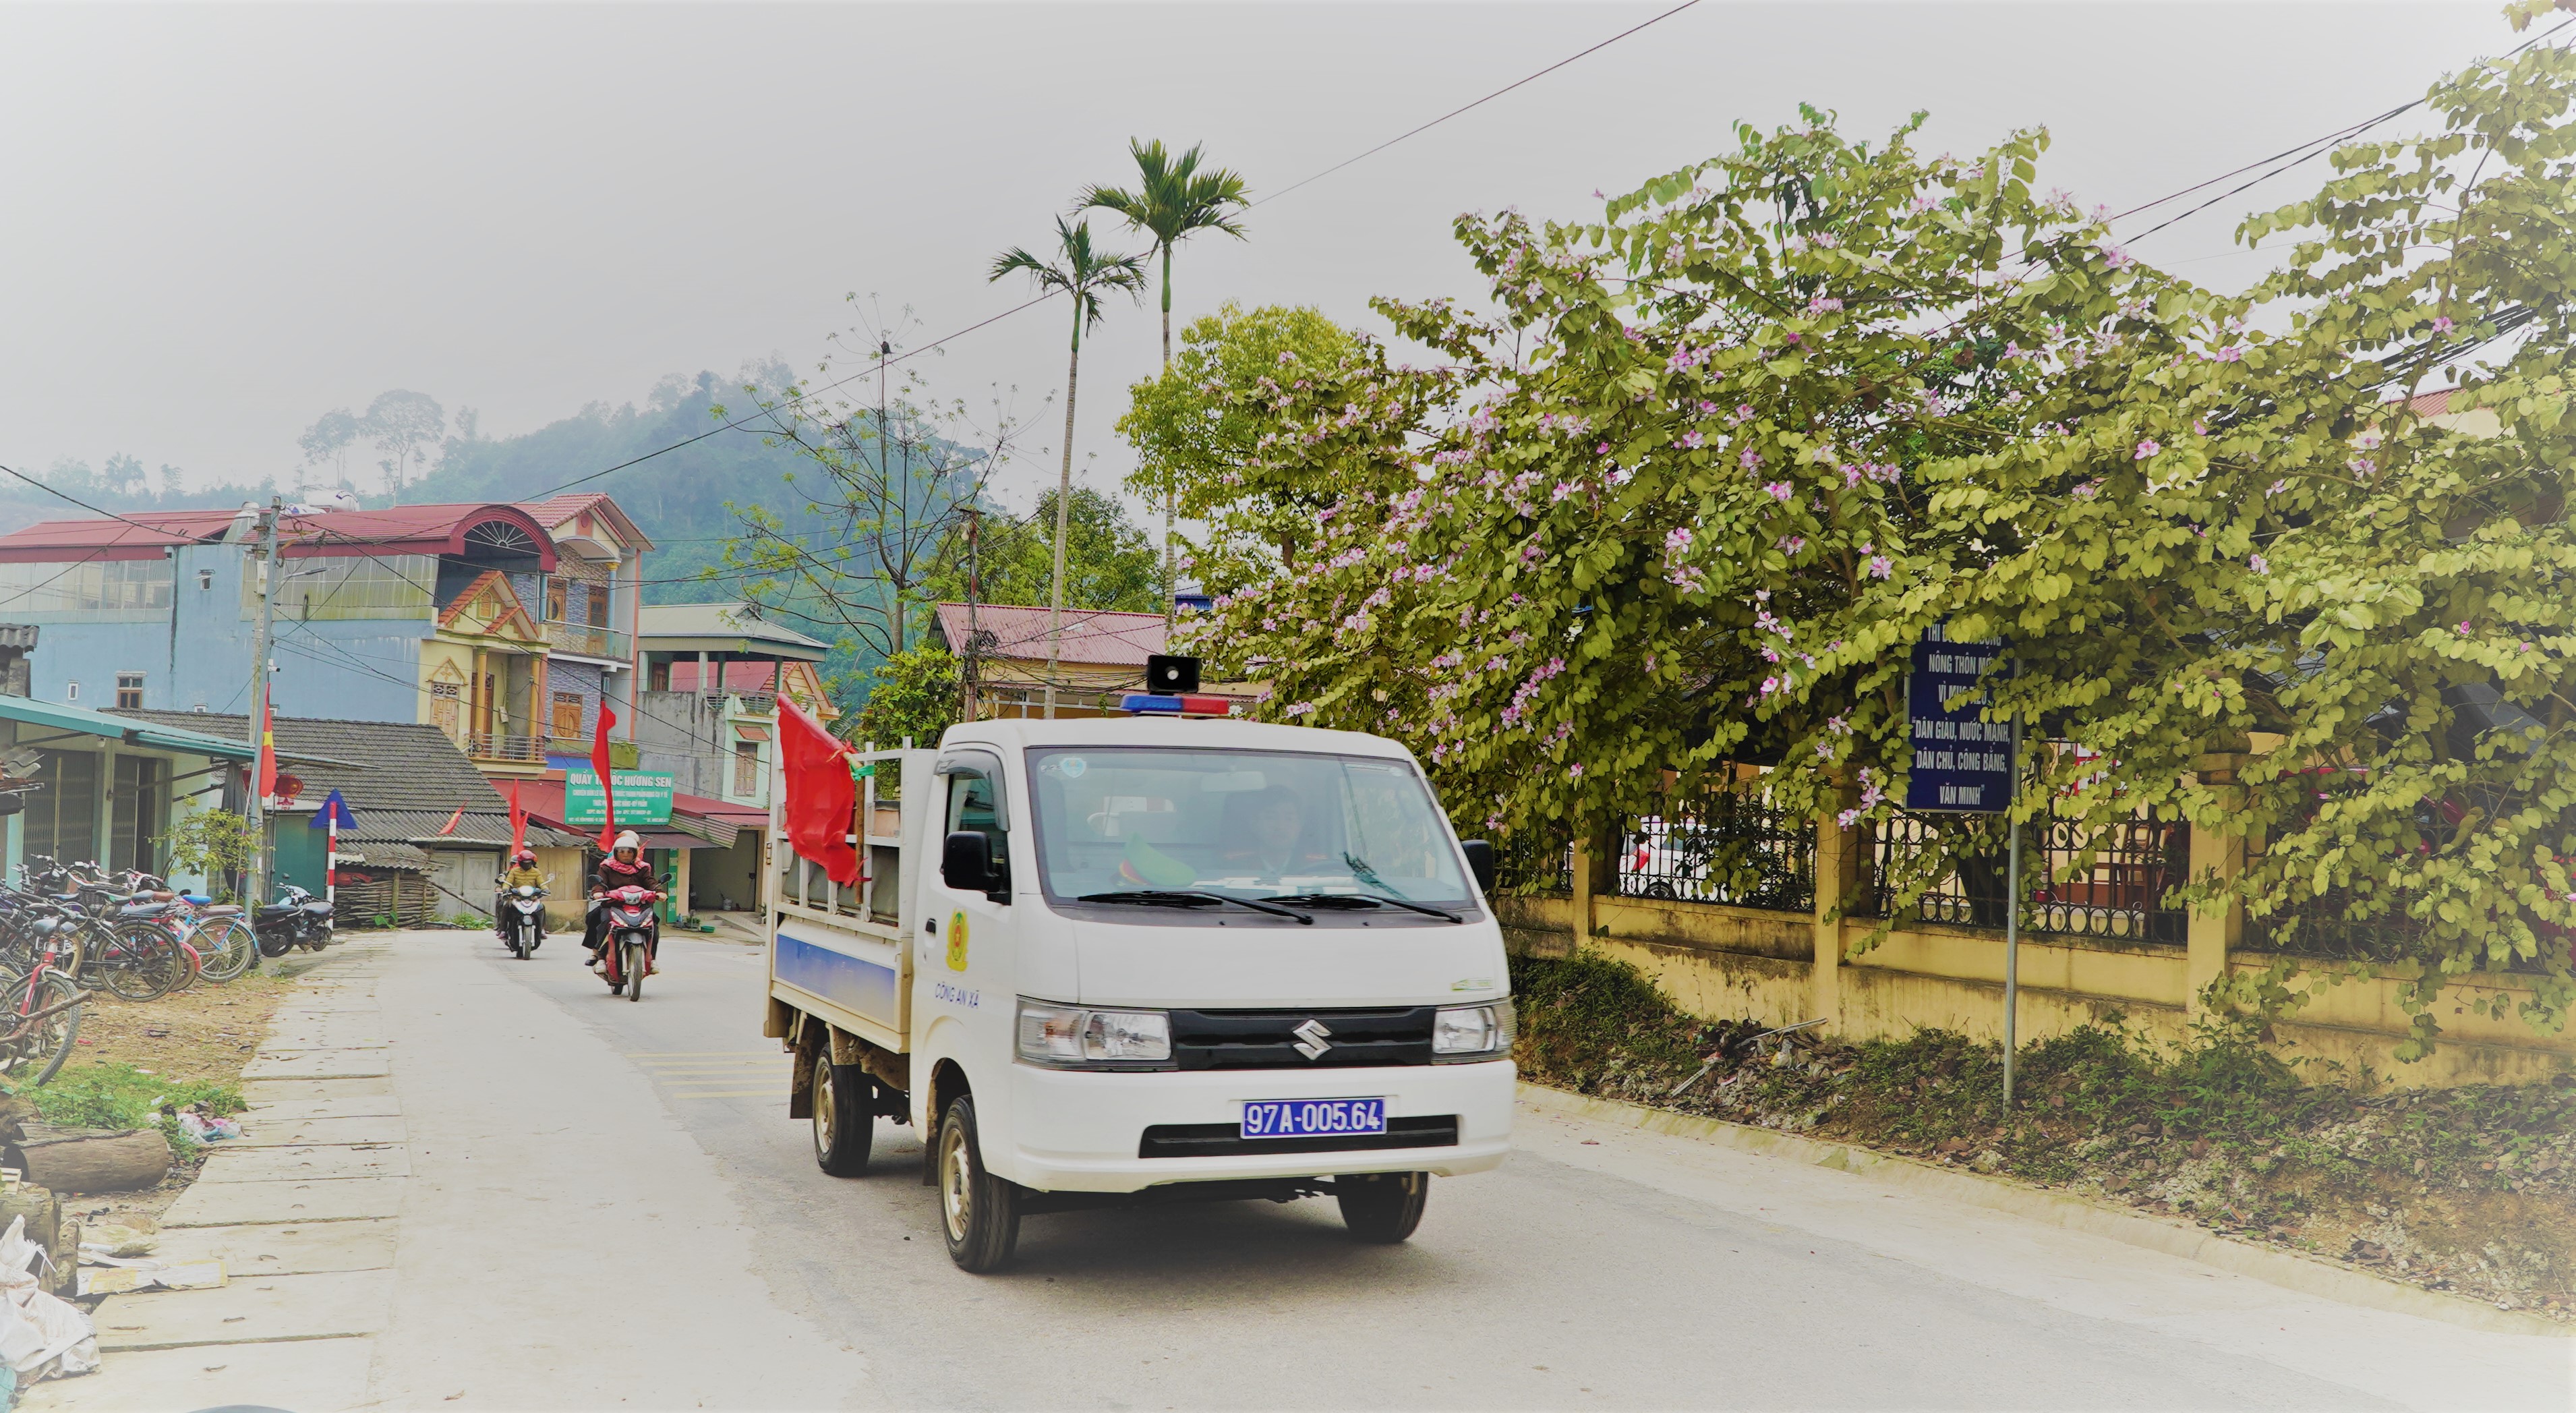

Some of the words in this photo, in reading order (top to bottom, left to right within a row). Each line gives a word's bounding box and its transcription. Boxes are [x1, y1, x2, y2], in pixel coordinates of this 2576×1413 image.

[1929, 650, 1952, 673] NÔNG
[1955, 652, 1976, 674] THÔN
[1939, 681, 1946, 703] VÌ
[1935, 717, 1957, 742] GIÀU,
[1960, 717, 1982, 741] NƯỚC
[1984, 723, 2010, 745] MẠNH,
[1916, 747, 1935, 769] DÂN
[1937, 745, 1956, 772] CHỦ,
[1958, 748, 1980, 771] CÔNG
[1983, 746, 2008, 774] BẰNG,
[624, 775, 653, 787] HƯƠNG
[655, 776, 672, 788] SEN
[1939, 782, 1956, 804] VĂN
[935, 981, 955, 1002] CÔNG
[955, 989, 966, 1006] AN
[967, 989, 979, 1009] XÃ
[1247, 1101, 1382, 1134] 97A-005.64
